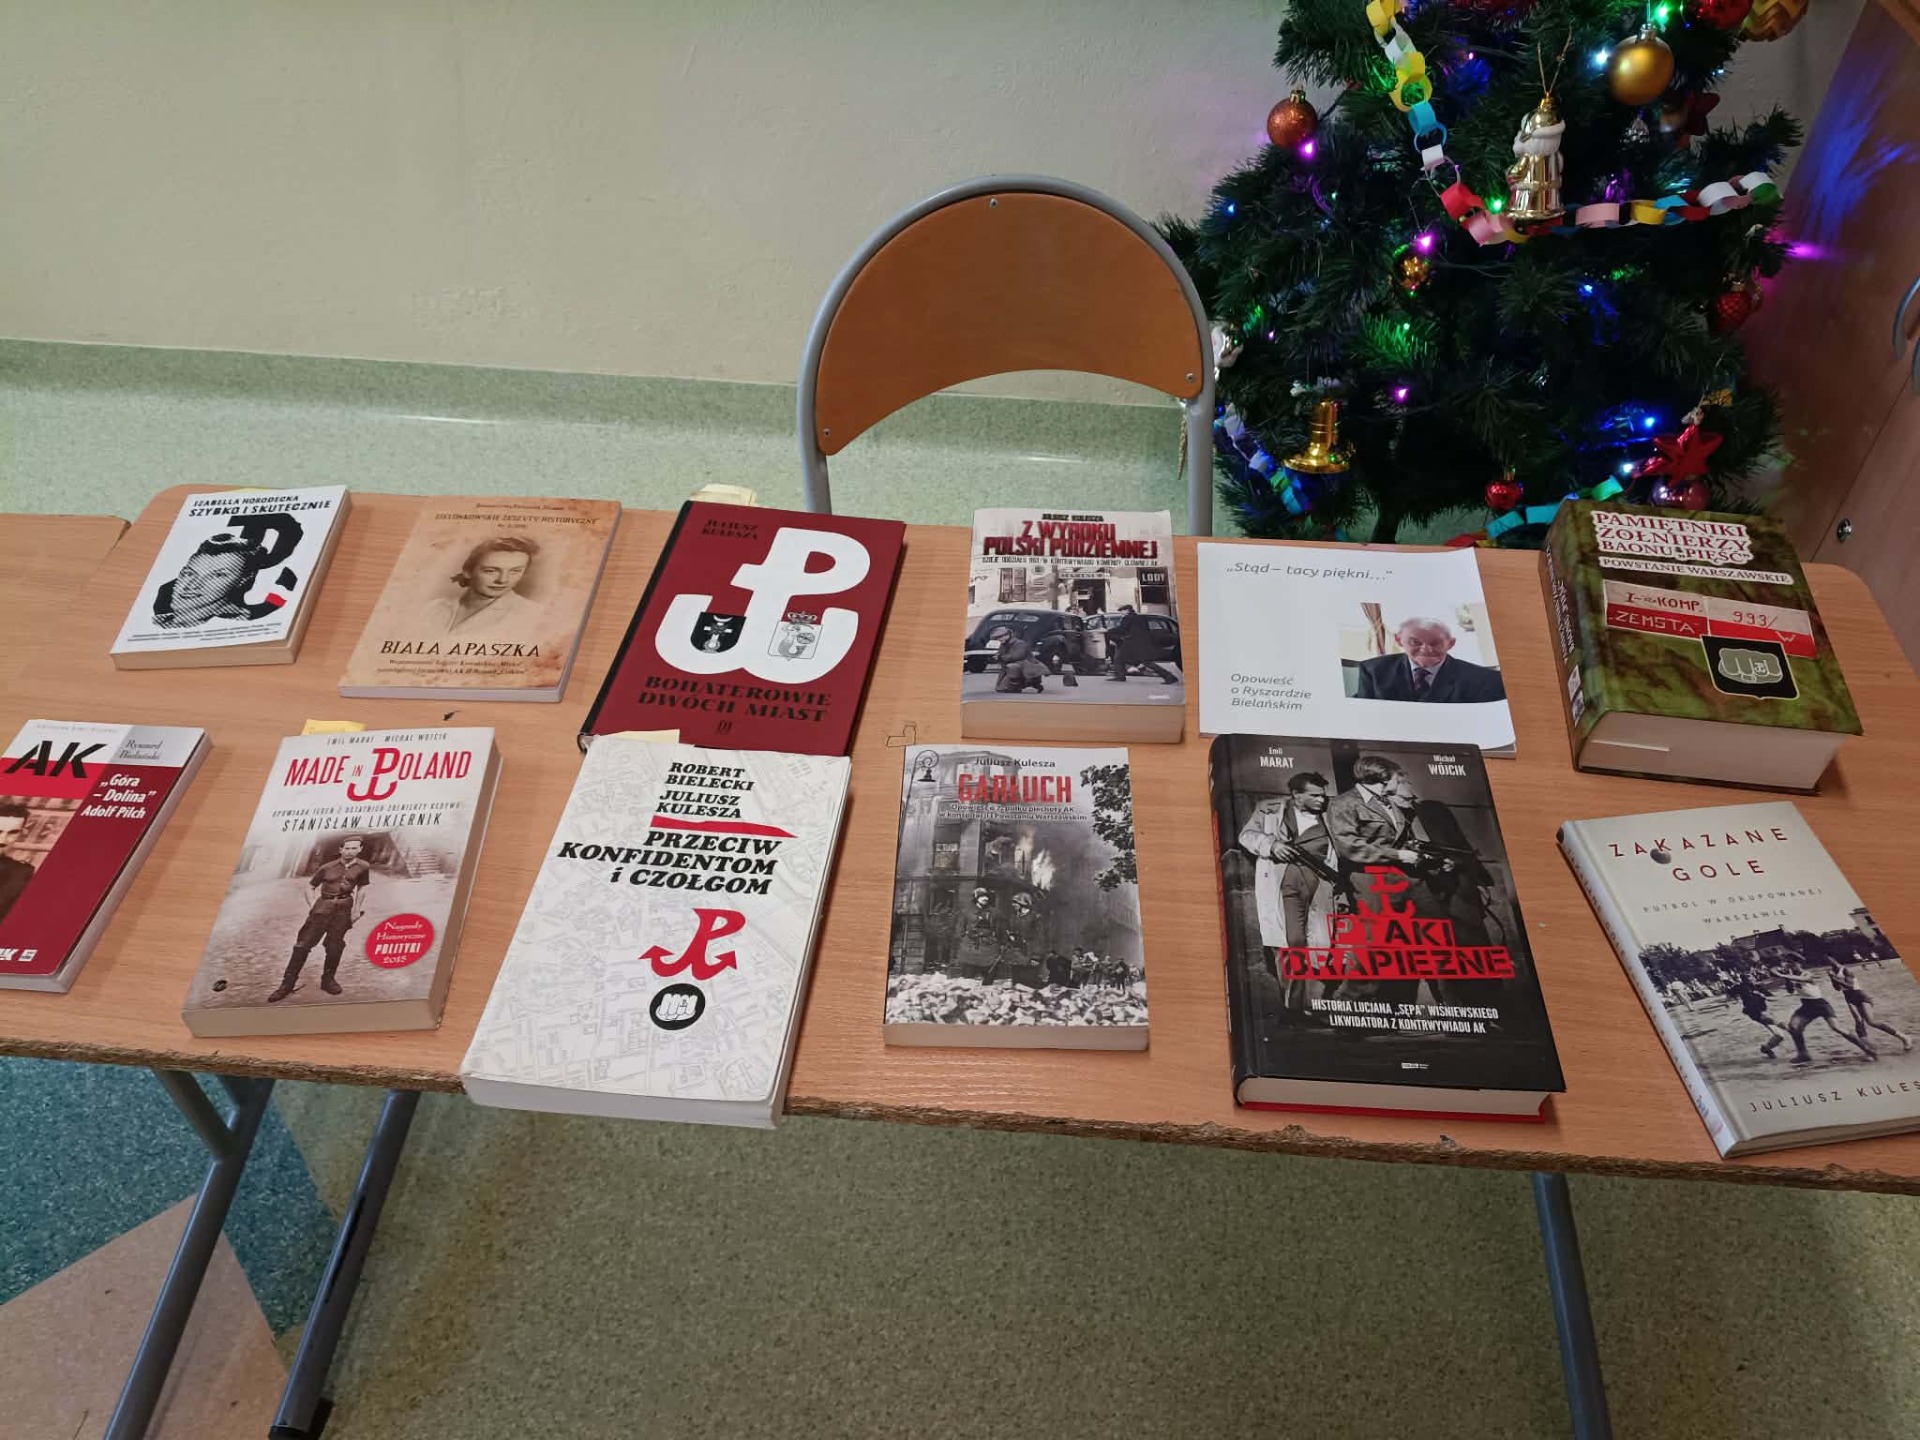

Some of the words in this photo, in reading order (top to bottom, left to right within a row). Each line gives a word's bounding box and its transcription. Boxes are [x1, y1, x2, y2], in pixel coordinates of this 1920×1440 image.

[189, 506, 240, 517] SZYBKO
[251, 500, 332, 514] SKUTECZNIE
[193, 498, 240, 507] IZABELLA
[242, 495, 299, 505] HORODECKA
[1021, 520, 1034, 538] Z
[1037, 520, 1116, 541] WYROKU
[1596, 512, 1745, 538] PAMIĘTNIKI
[1599, 525, 1748, 551] ŻOŁNIERZY
[983, 536, 1046, 556] POLSKI
[1049, 539, 1158, 560] PODZIEMNEJ
[1602, 540, 1673, 556] BAONU
[1286, 565, 1319, 577] tacy
[1602, 558, 1687, 574] POWSTANIE
[1687, 566, 1791, 583] WARSZAWSKIE
[447, 642, 540, 657] APASZKA
[1231, 673, 1294, 686] Opowieść
[644, 675, 832, 706] BOHATEROWIE
[1243, 686, 1312, 699] Ryszardzie
[637, 690, 736, 713] DWÓCH
[745, 703, 827, 722] MIAST
[1231, 697, 1302, 711] Bielańskim
[4, 740, 108, 779] AK
[1268, 747, 1283, 755] Emil
[668, 762, 745, 778] ROBERT
[974, 758, 1011, 767] Juliusz
[1014, 758, 1056, 769] Kulesza
[1259, 756, 1295, 769] MARAT
[1427, 762, 1467, 776] WÓJCIK
[283, 755, 351, 787] MADE
[352, 764, 364, 777] IN
[370, 748, 472, 799] POLAND
[664, 774, 755, 791] BIELECKI
[659, 790, 742, 806] JULIUSZ
[80, 805, 117, 818] Adolf
[116, 806, 146, 819] Pilch
[655, 802, 742, 819] KULESZA
[1035, 813, 1087, 821] Warszawskim
[282, 816, 361, 832] STANISŁAW
[368, 812, 442, 829] LIKIERNIK
[642, 831, 783, 856] PRZECIW
[1608, 828, 1788, 857] ZAKAZANE
[557, 842, 779, 876] KONFIDENTOM
[1672, 860, 1765, 882] GOLE
[610, 867, 622, 883] i
[629, 869, 773, 895] CZOŁGOM
[1643, 900, 1699, 914] FUTBOL
[1728, 887, 1823, 903] OKUPOWANEJ
[1702, 909, 1787, 924] WARSZAWIE
[1332, 918, 1453, 947] PTAKI
[374, 943, 421, 955] POLITYKI
[1311, 999, 1350, 1013] HISTORIA
[1353, 1002, 1393, 1015] LUCIANA
[1427, 1003, 1499, 1020] WIŚNIEWSKIEGO
[1329, 1014, 1390, 1029] LIKWIDATORA
[1391, 1018, 1398, 1030] Z
[1399, 1018, 1471, 1033] KONTRWYWIADU
[1473, 1022, 1487, 1034] AK
[1750, 1091, 1842, 1113] JULIUSZ
